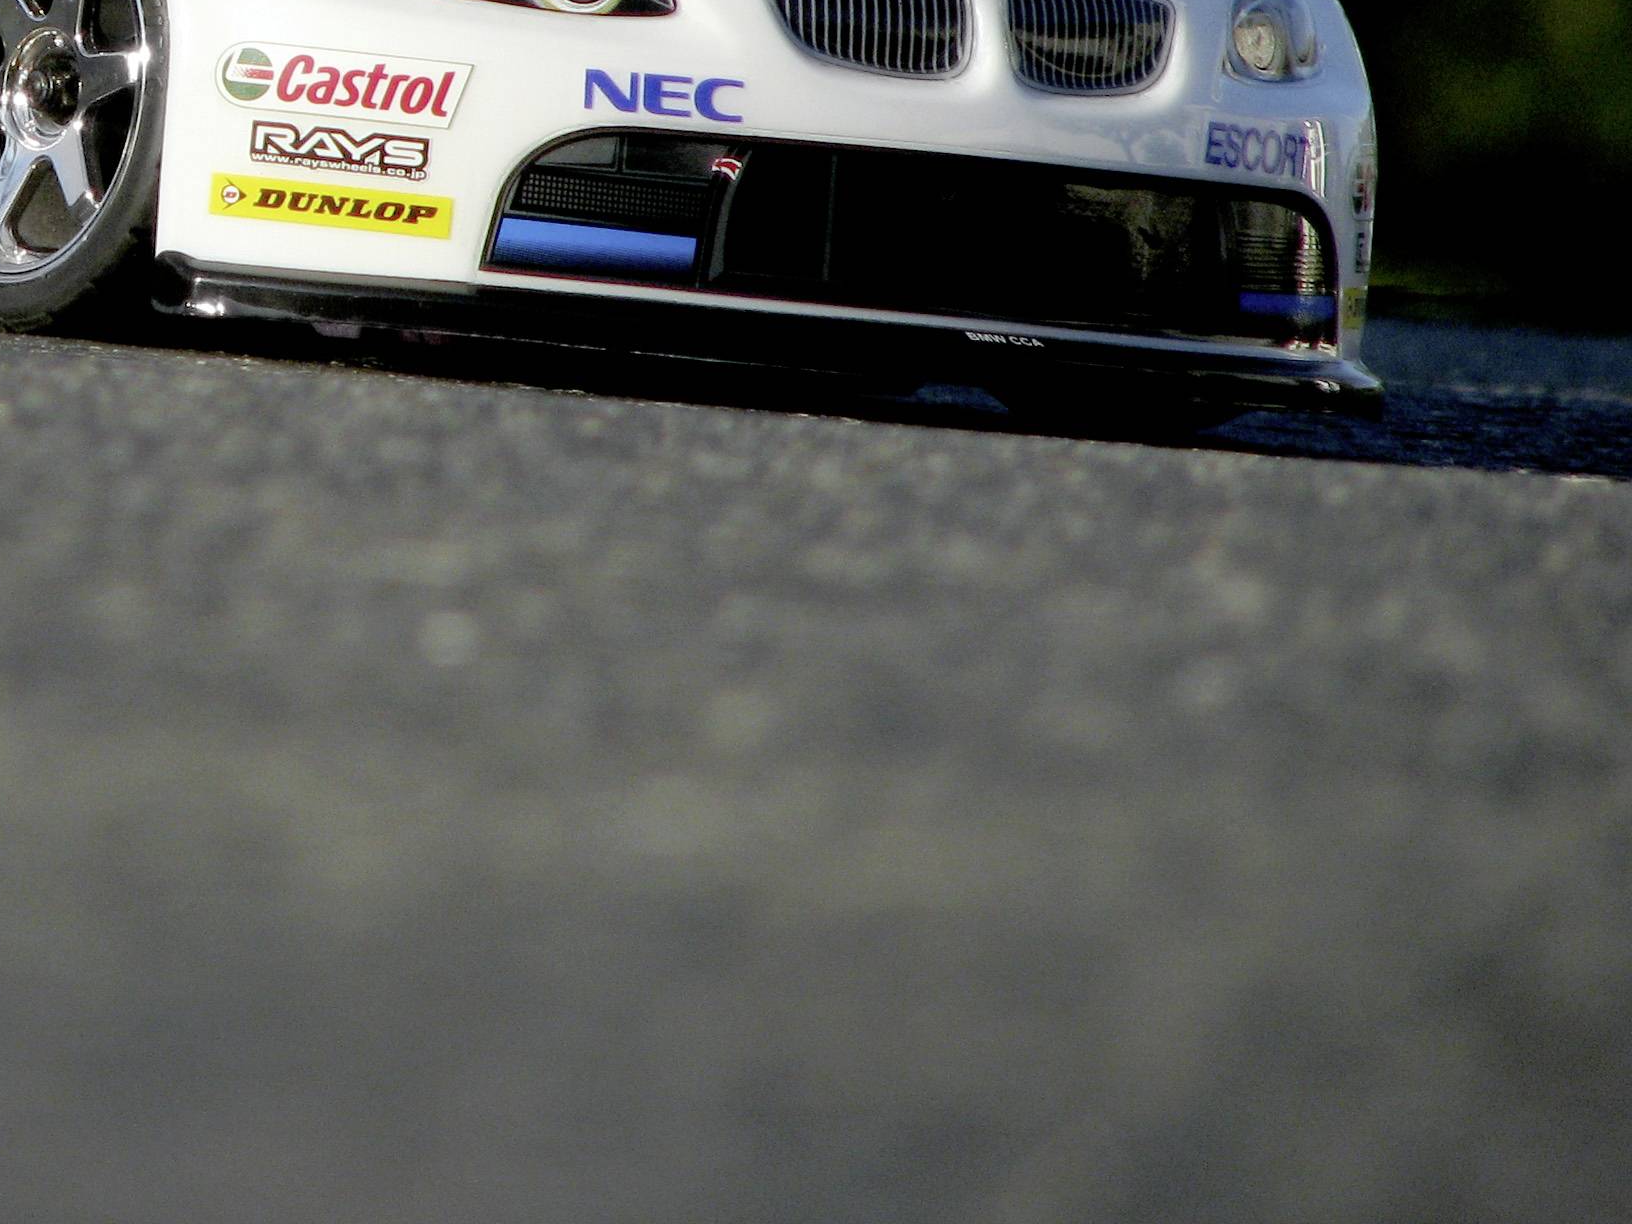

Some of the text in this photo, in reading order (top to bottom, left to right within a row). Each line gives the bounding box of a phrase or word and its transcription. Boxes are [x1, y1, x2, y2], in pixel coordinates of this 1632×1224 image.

[276, 54, 456, 118] Castrol
[583, 68, 745, 123] NEC
[251, 150, 427, 182] www.rayswheels.co.jp
[252, 124, 426, 169] RAYS
[253, 187, 439, 225] DUNLOP
[965, 331, 1045, 348] BMW CCA
